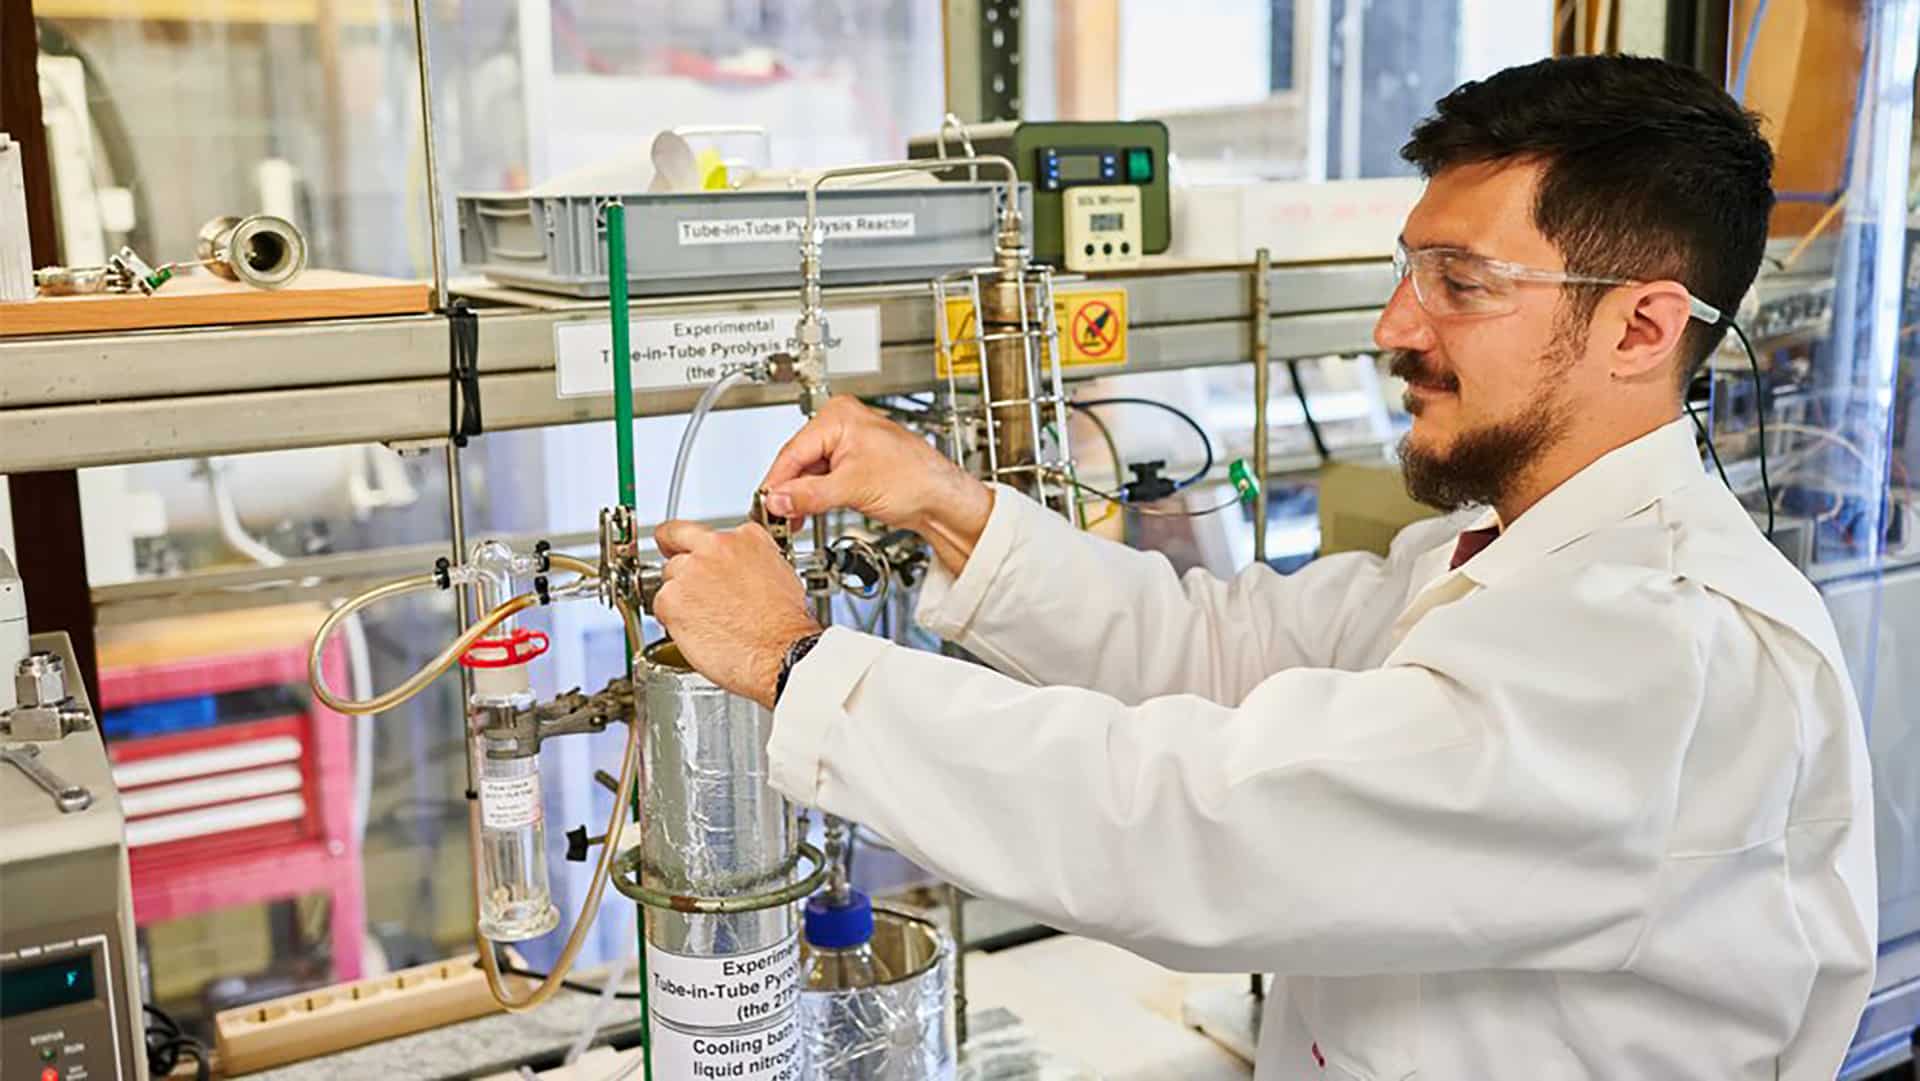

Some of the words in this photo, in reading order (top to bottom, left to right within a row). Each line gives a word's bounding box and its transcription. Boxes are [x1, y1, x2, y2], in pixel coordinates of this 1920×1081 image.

[683, 220, 783, 238] Tube-in-Tube
[857, 217, 910, 231] Reactor
[674, 319, 775, 338] Experimental
[601, 344, 707, 363] Te-in-Tube
[711, 340, 781, 361] Pyrolysis
[686, 365, 715, 383] (the
[654, 973, 760, 999] Tube-in-Tube
[737, 1002, 770, 1022] (the
[693, 1038, 762, 1056] Cooling
[694, 1060, 743, 1079] liquid
